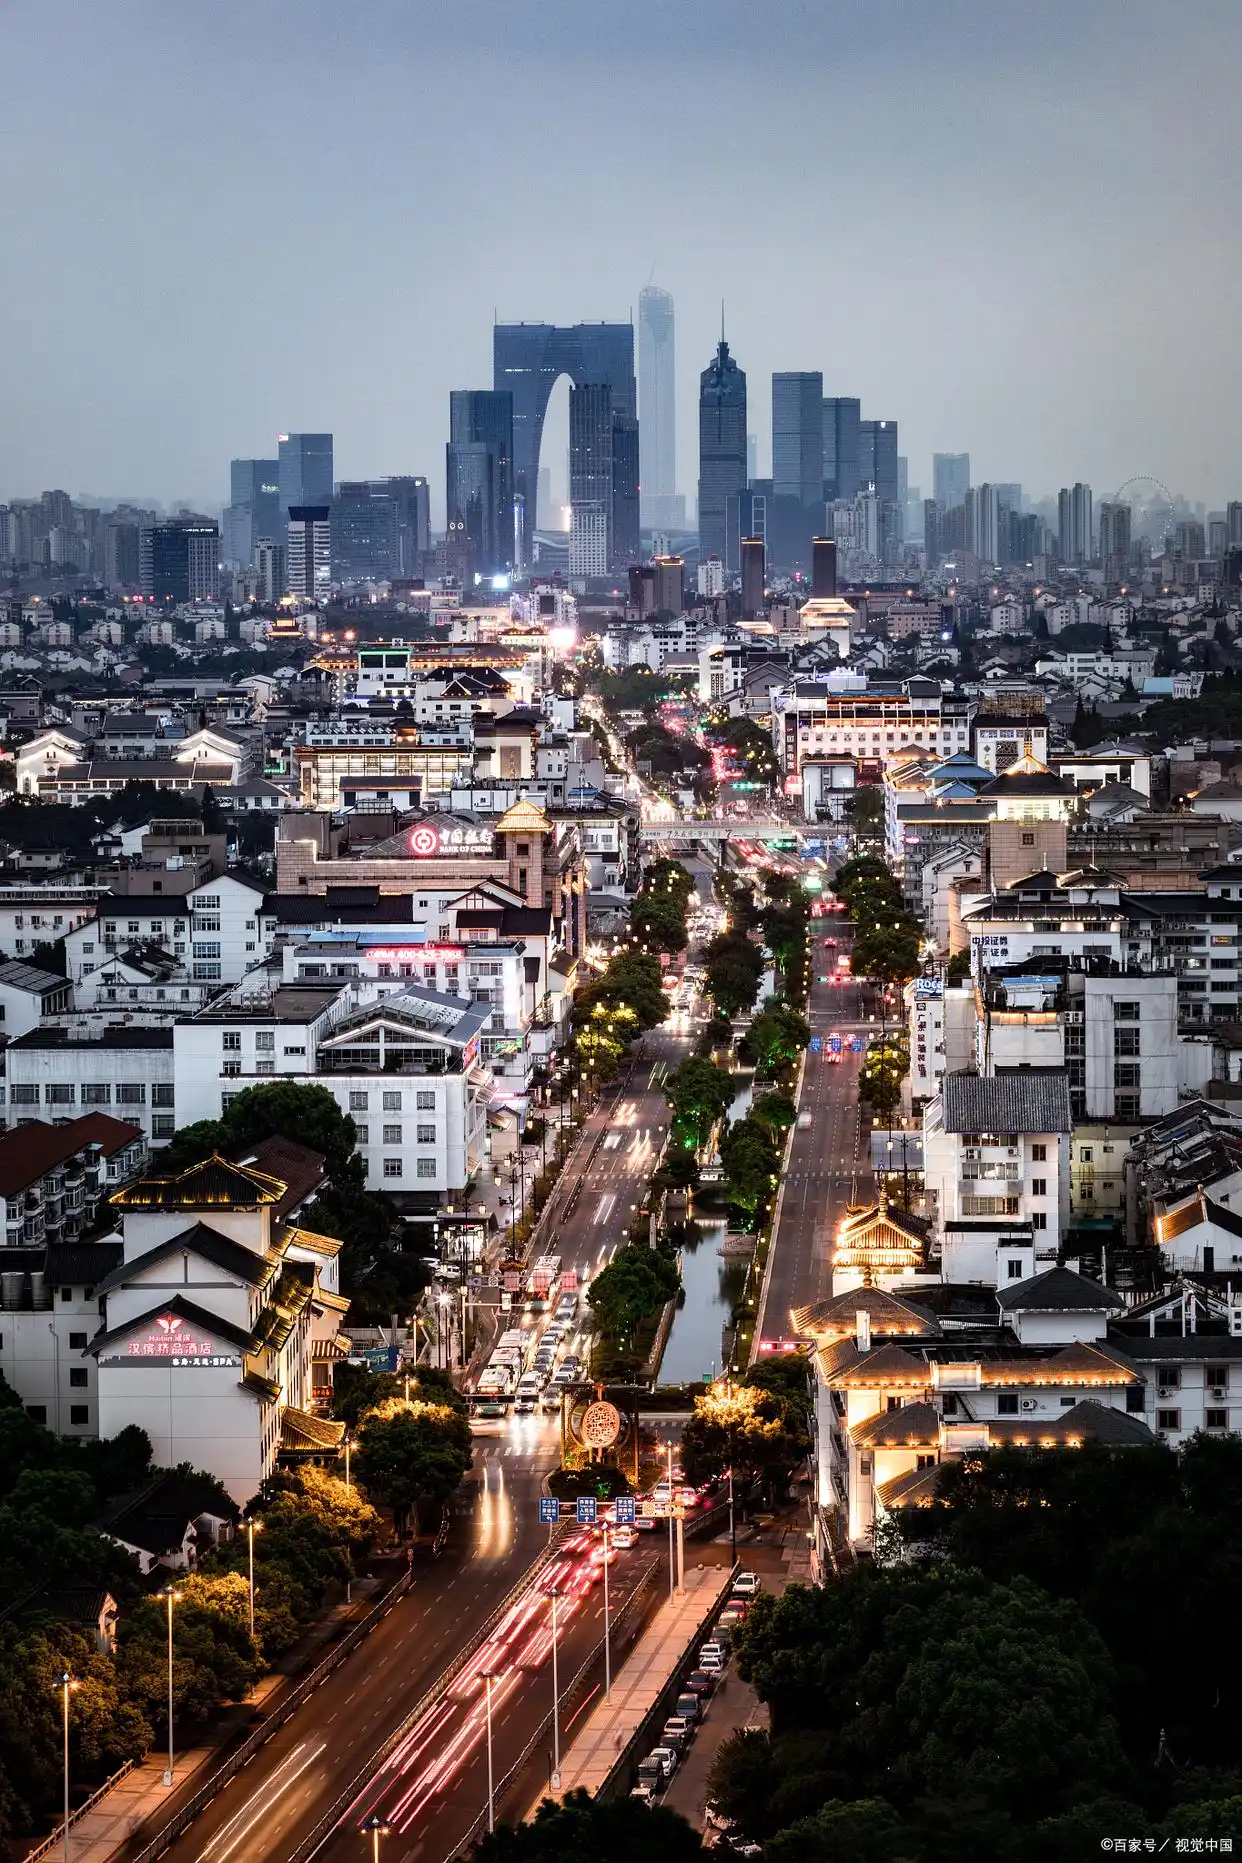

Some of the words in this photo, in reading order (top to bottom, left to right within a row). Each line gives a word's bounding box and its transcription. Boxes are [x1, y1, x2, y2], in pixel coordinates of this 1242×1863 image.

[440, 828, 494, 845] 中国银行
[440, 845, 459, 853] BANK
[460, 845, 469, 853] OF
[470, 845, 493, 853] CHINA
[916, 978, 944, 989] Roca
